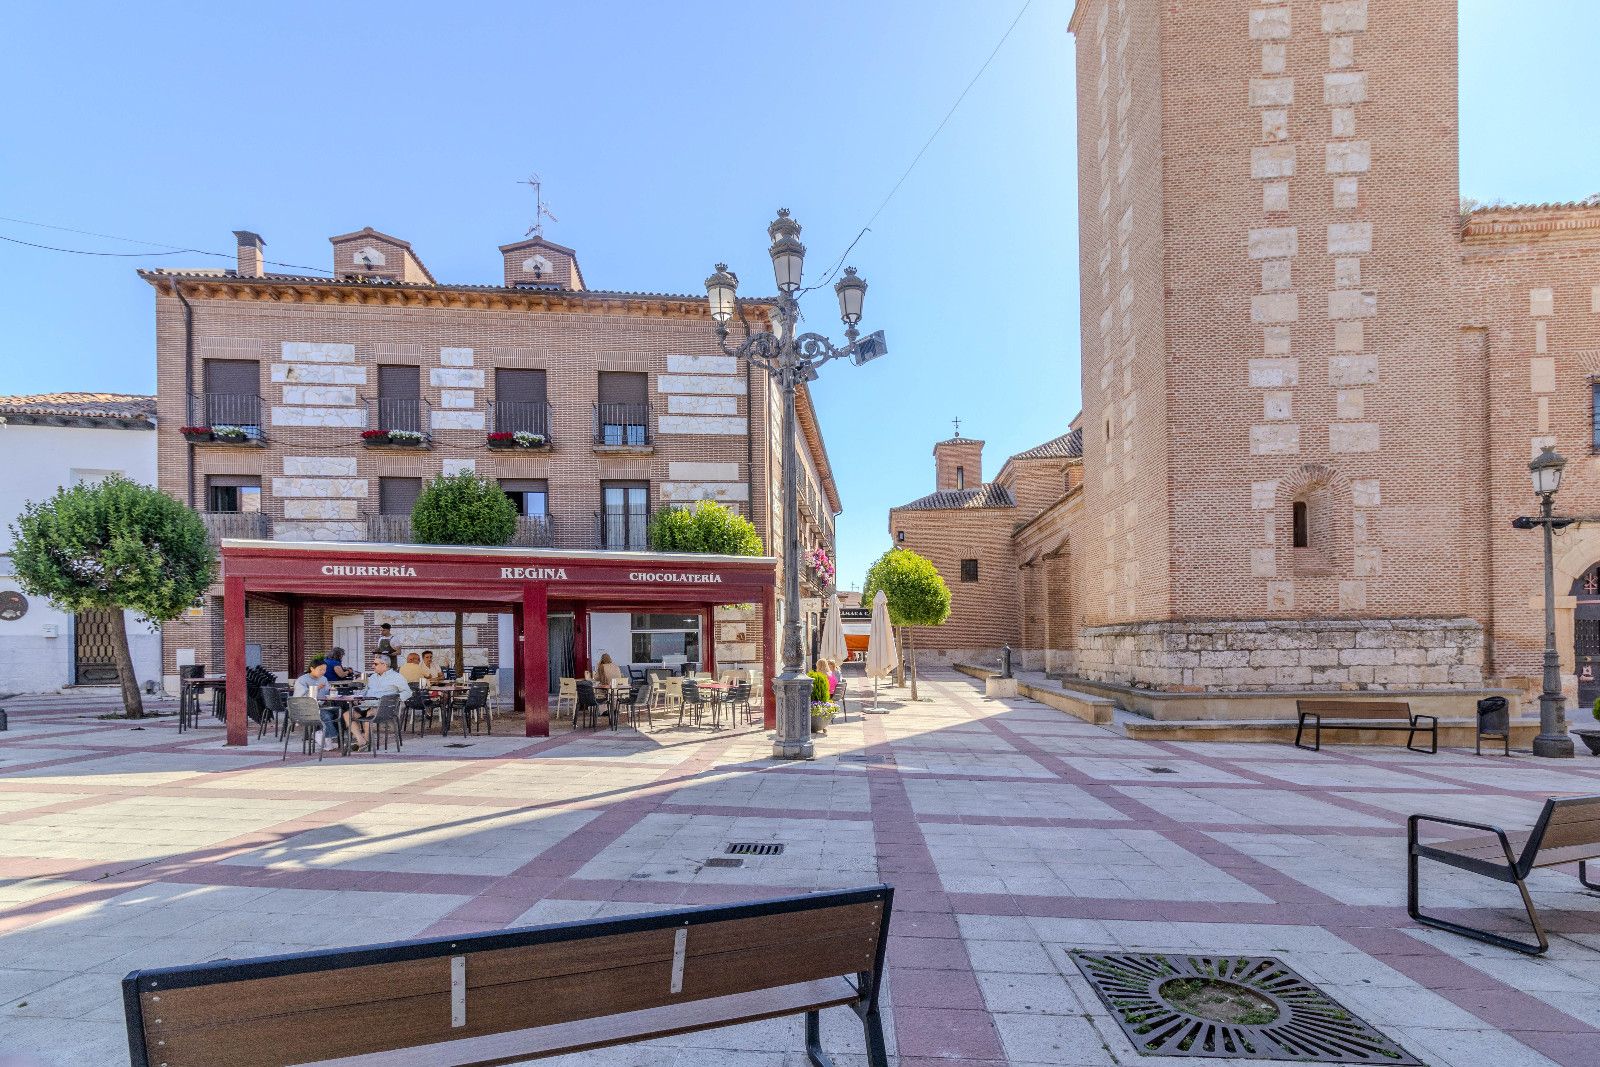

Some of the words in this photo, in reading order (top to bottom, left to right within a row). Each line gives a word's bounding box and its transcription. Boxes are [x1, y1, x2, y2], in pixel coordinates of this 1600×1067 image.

[321, 564, 417, 577] CHURRERÍA
[500, 567, 568, 580] REGINA
[629, 572, 722, 583] CHOCOLATERÍA
